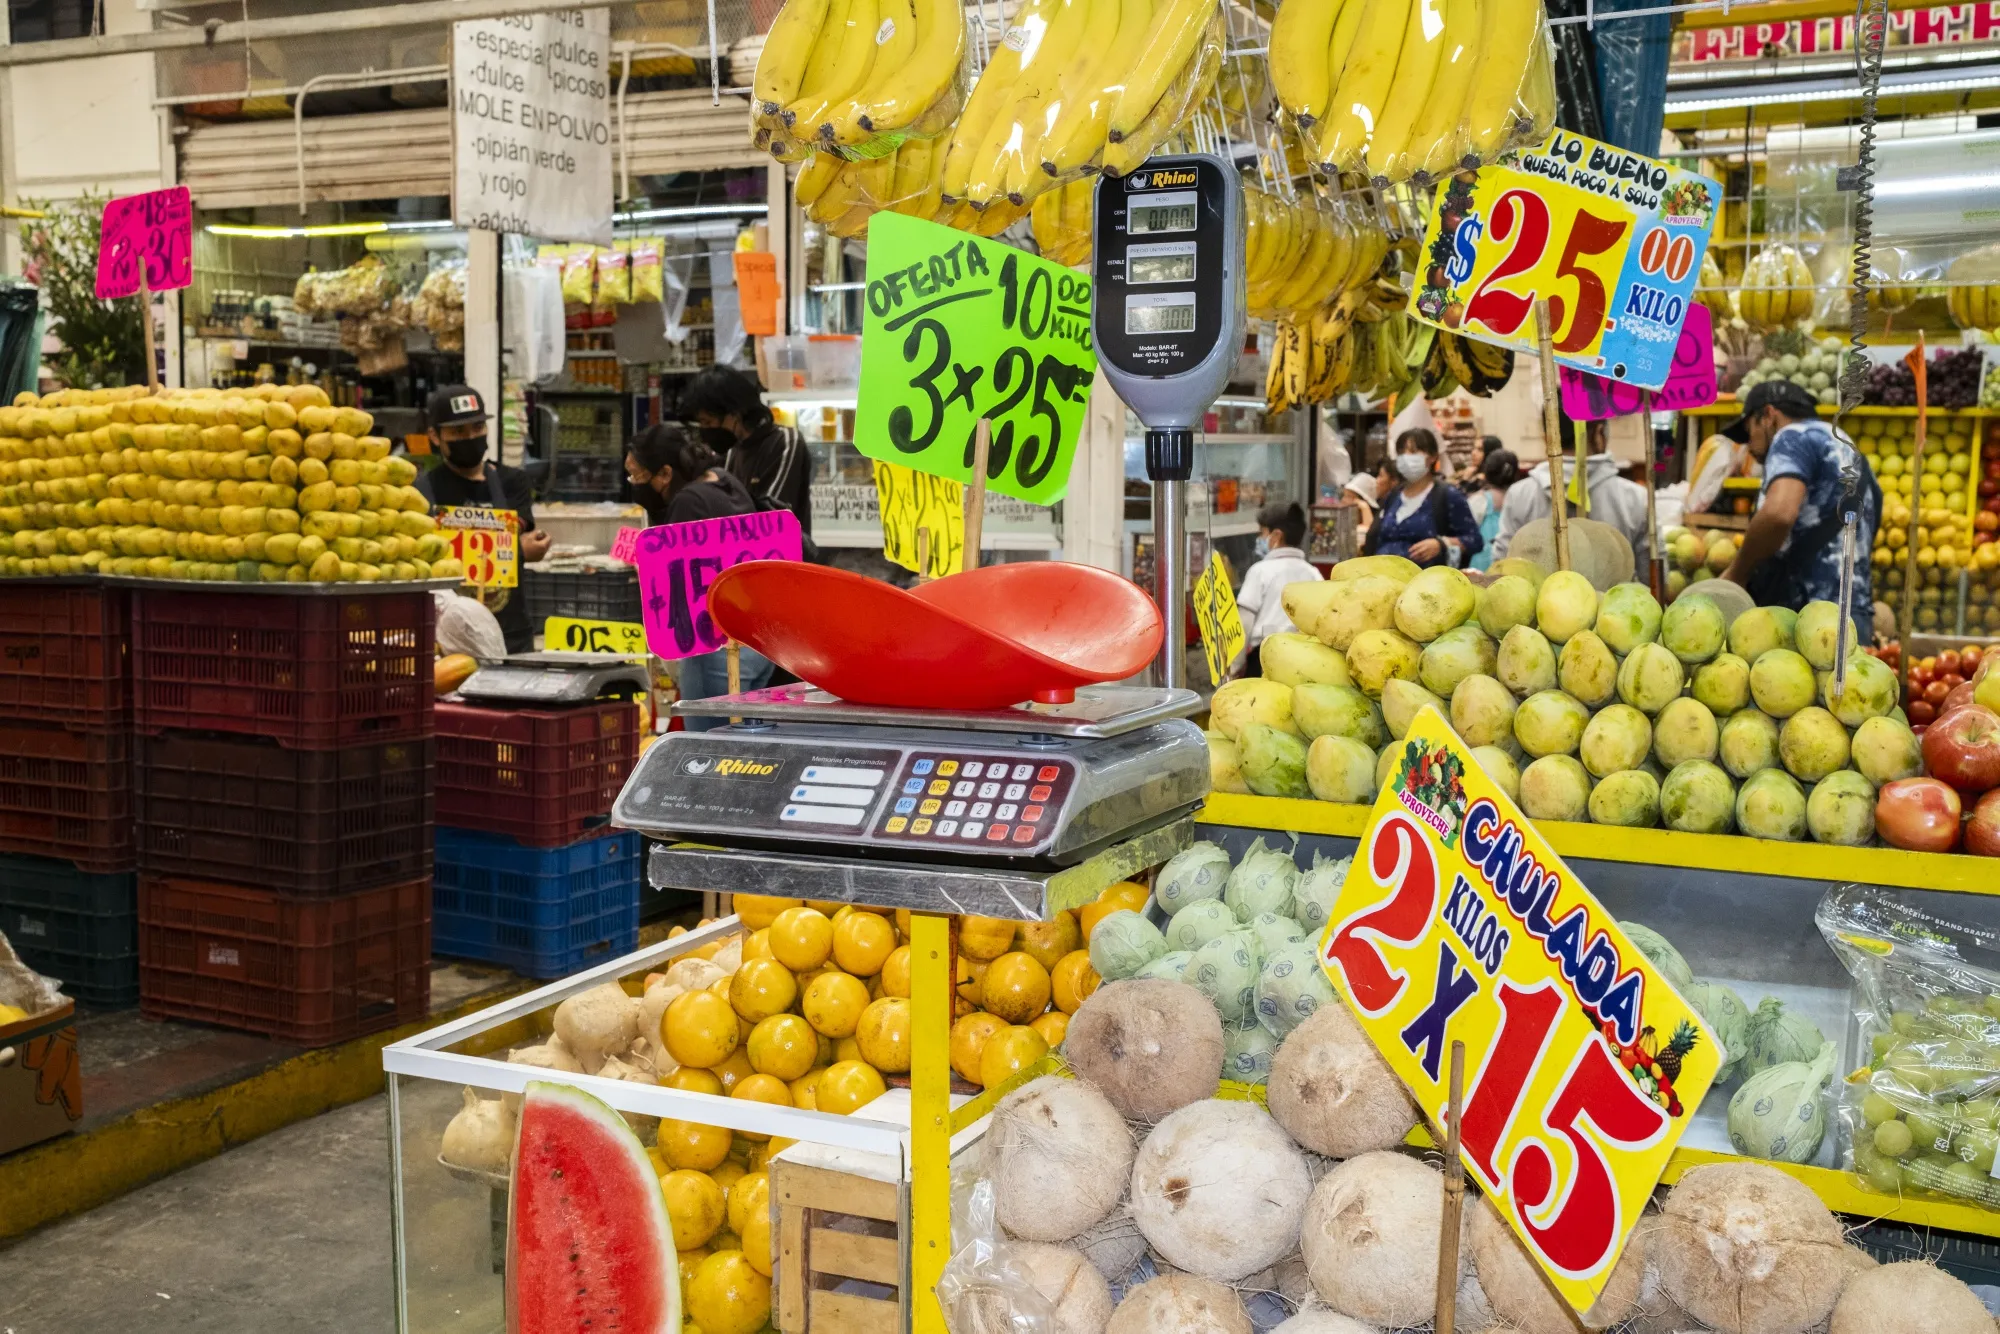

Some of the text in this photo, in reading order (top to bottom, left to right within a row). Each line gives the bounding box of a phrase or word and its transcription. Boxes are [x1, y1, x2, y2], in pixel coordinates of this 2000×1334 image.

[475, 31, 599, 69] especial dulce
[475, 60, 606, 100] dulce picoso
[460, 89, 609, 146] MOLE EN POLVO
[476, 132, 576, 174] pipián verde
[1550, 132, 1668, 192] LO BUENO
[479, 171, 527, 201] y rojo
[1152, 171, 1196, 188] Rhino
[1523, 154, 1658, 211] QUEDA POCO A SOLO
[1664, 214, 1704, 226] APROVECHE
[1639, 228, 1695, 281] 00
[867, 240, 990, 318] OFERTA
[997, 253, 1052, 341] 10
[1625, 283, 1684, 327] KILO
[888, 318, 951, 454] 3
[454, 508, 495, 520] COMA
[449, 531, 495, 584] 13
[714, 758, 774, 776] Rhino
[843, 758, 887, 766] Programadas
[916, 761, 930, 770] M1
[940, 763, 954, 772] M+
[970, 764, 978, 774] 7
[993, 765, 1001, 776] 8
[1018, 767, 1026, 777] 9
[907, 781, 921, 790] M2
[931, 783, 947, 791] MC
[960, 782, 967, 794] 4
[985, 784, 993, 795] 5
[1010, 786, 1018, 797] 6
[898, 800, 912, 809] M3
[921, 802, 938, 810] MR
[953, 802, 959, 813] 1
[976, 803, 985, 815] 2
[1002, 805, 1010, 817] 3
[1397, 788, 1451, 839] APROVECHE
[942, 822, 950, 833] 0
[1325, 810, 1441, 1018] 2
[1461, 796, 1646, 1046] CHULADA
[1442, 873, 1511, 977] KILOS
[1935, 918, 1962, 931] BRAND
[1964, 927, 1995, 939] GRAPES
[1400, 940, 1671, 1280] X 15
